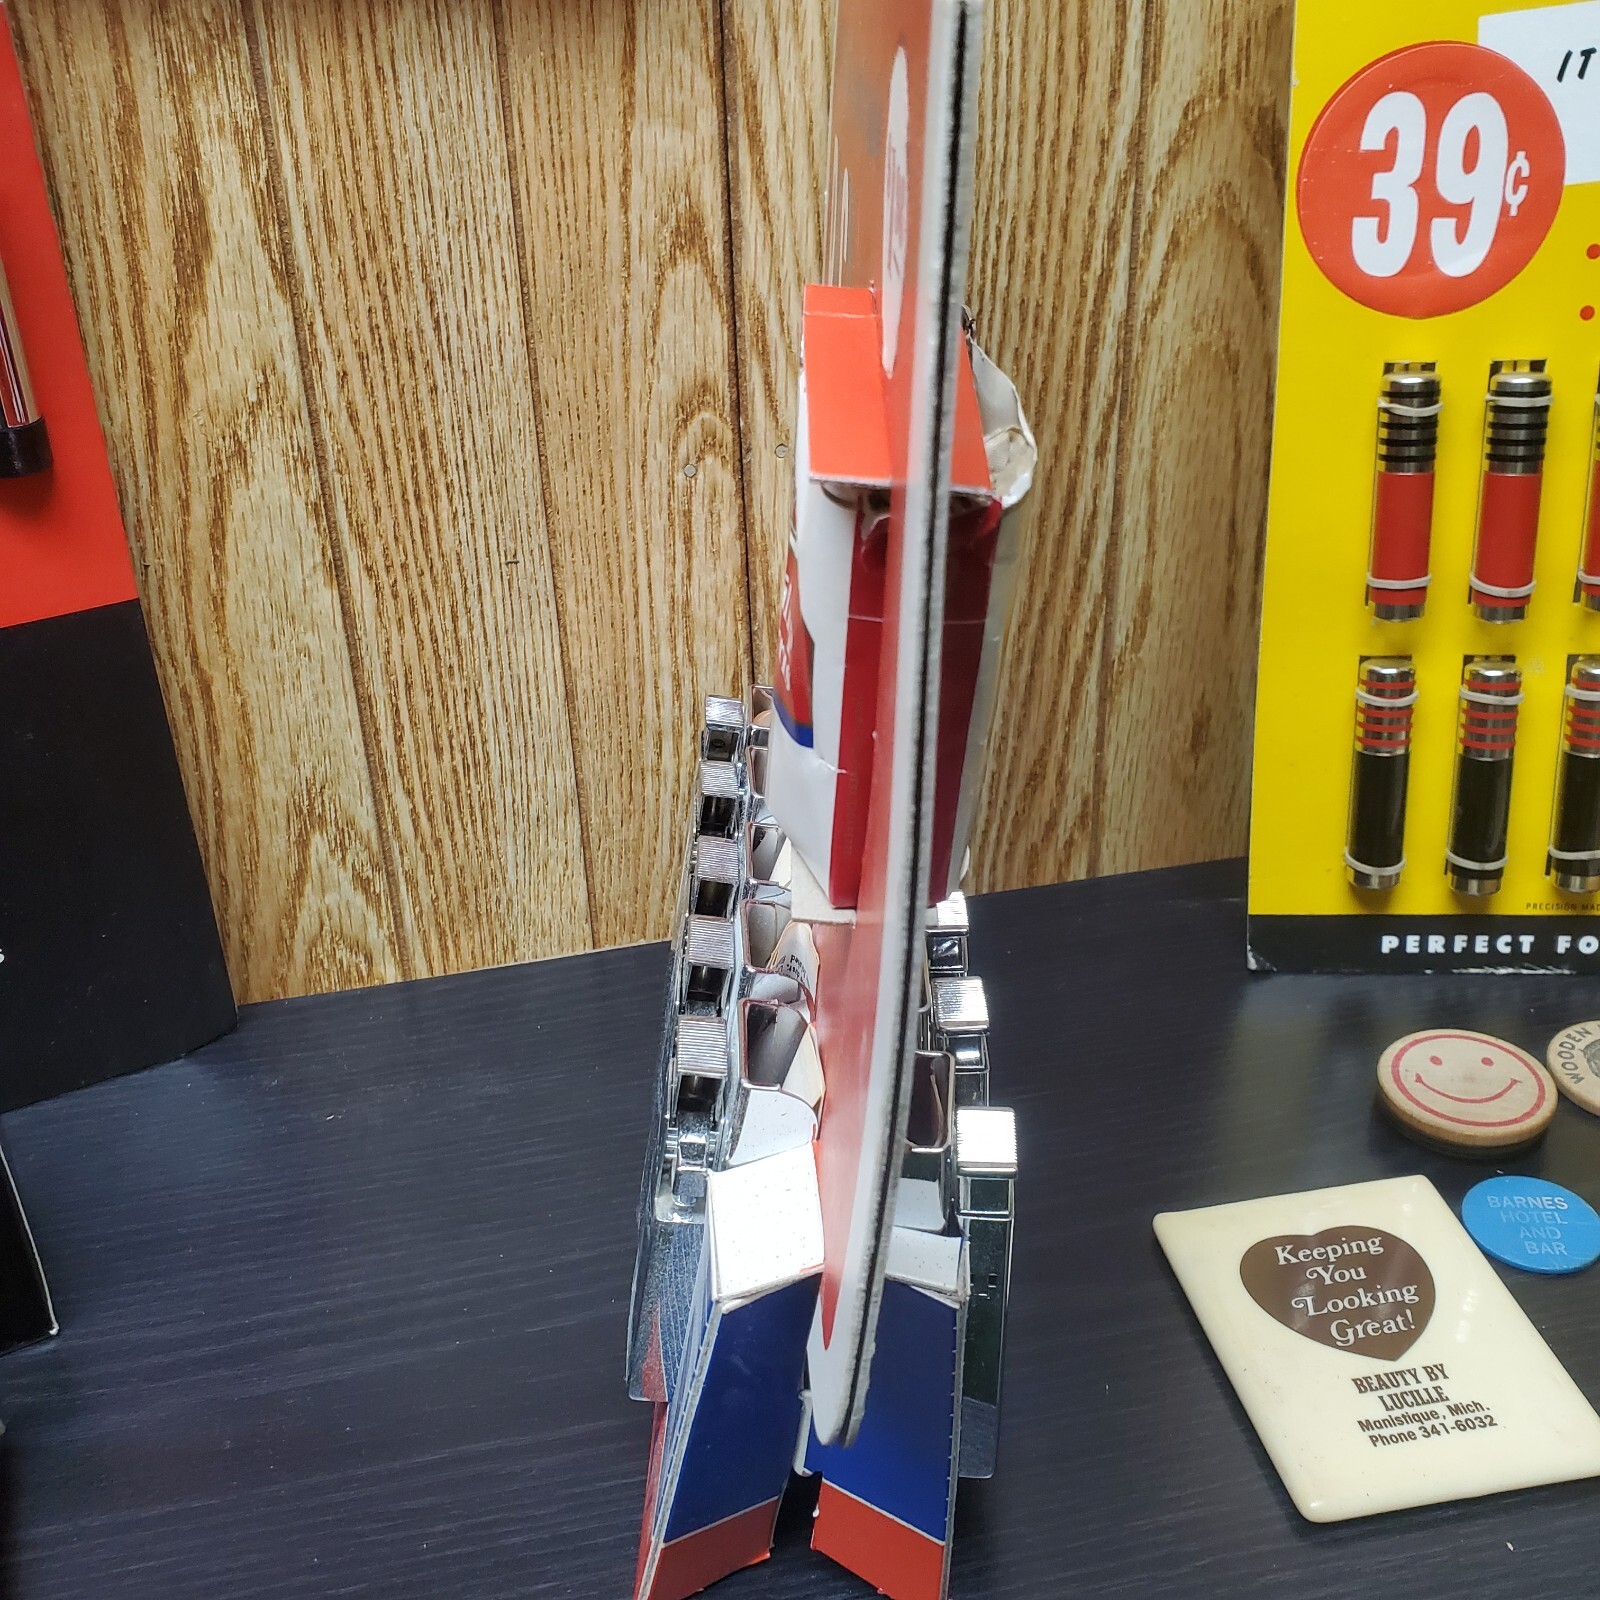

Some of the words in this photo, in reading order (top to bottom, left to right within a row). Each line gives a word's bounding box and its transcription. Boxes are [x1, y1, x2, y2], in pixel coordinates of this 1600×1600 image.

[1526, 902, 1577, 910] PRECISION
[1381, 935, 1535, 954] PERFECT
[1557, 1027, 1592, 1084] WOODEN
[1486, 1195, 1569, 1210] BARNES
[1500, 1210, 1569, 1225] HOTEL
[1520, 1225, 1562, 1240] AND
[1274, 1237, 1384, 1265] Keeping
[1524, 1241, 1568, 1255] BAR
[1306, 1264, 1367, 1285] You
[1291, 1284, 1420, 1317] Looking
[1329, 1308, 1416, 1347] Great!
[1351, 1367, 1422, 1394] BEAUTY
[1421, 1363, 1450, 1382] BY
[1377, 1385, 1450, 1412] LUCILLE
[1446, 1400, 1490, 1417] Mich.
[1368, 1430, 1418, 1447] Phone
[1418, 1414, 1498, 1439] 341-6032
